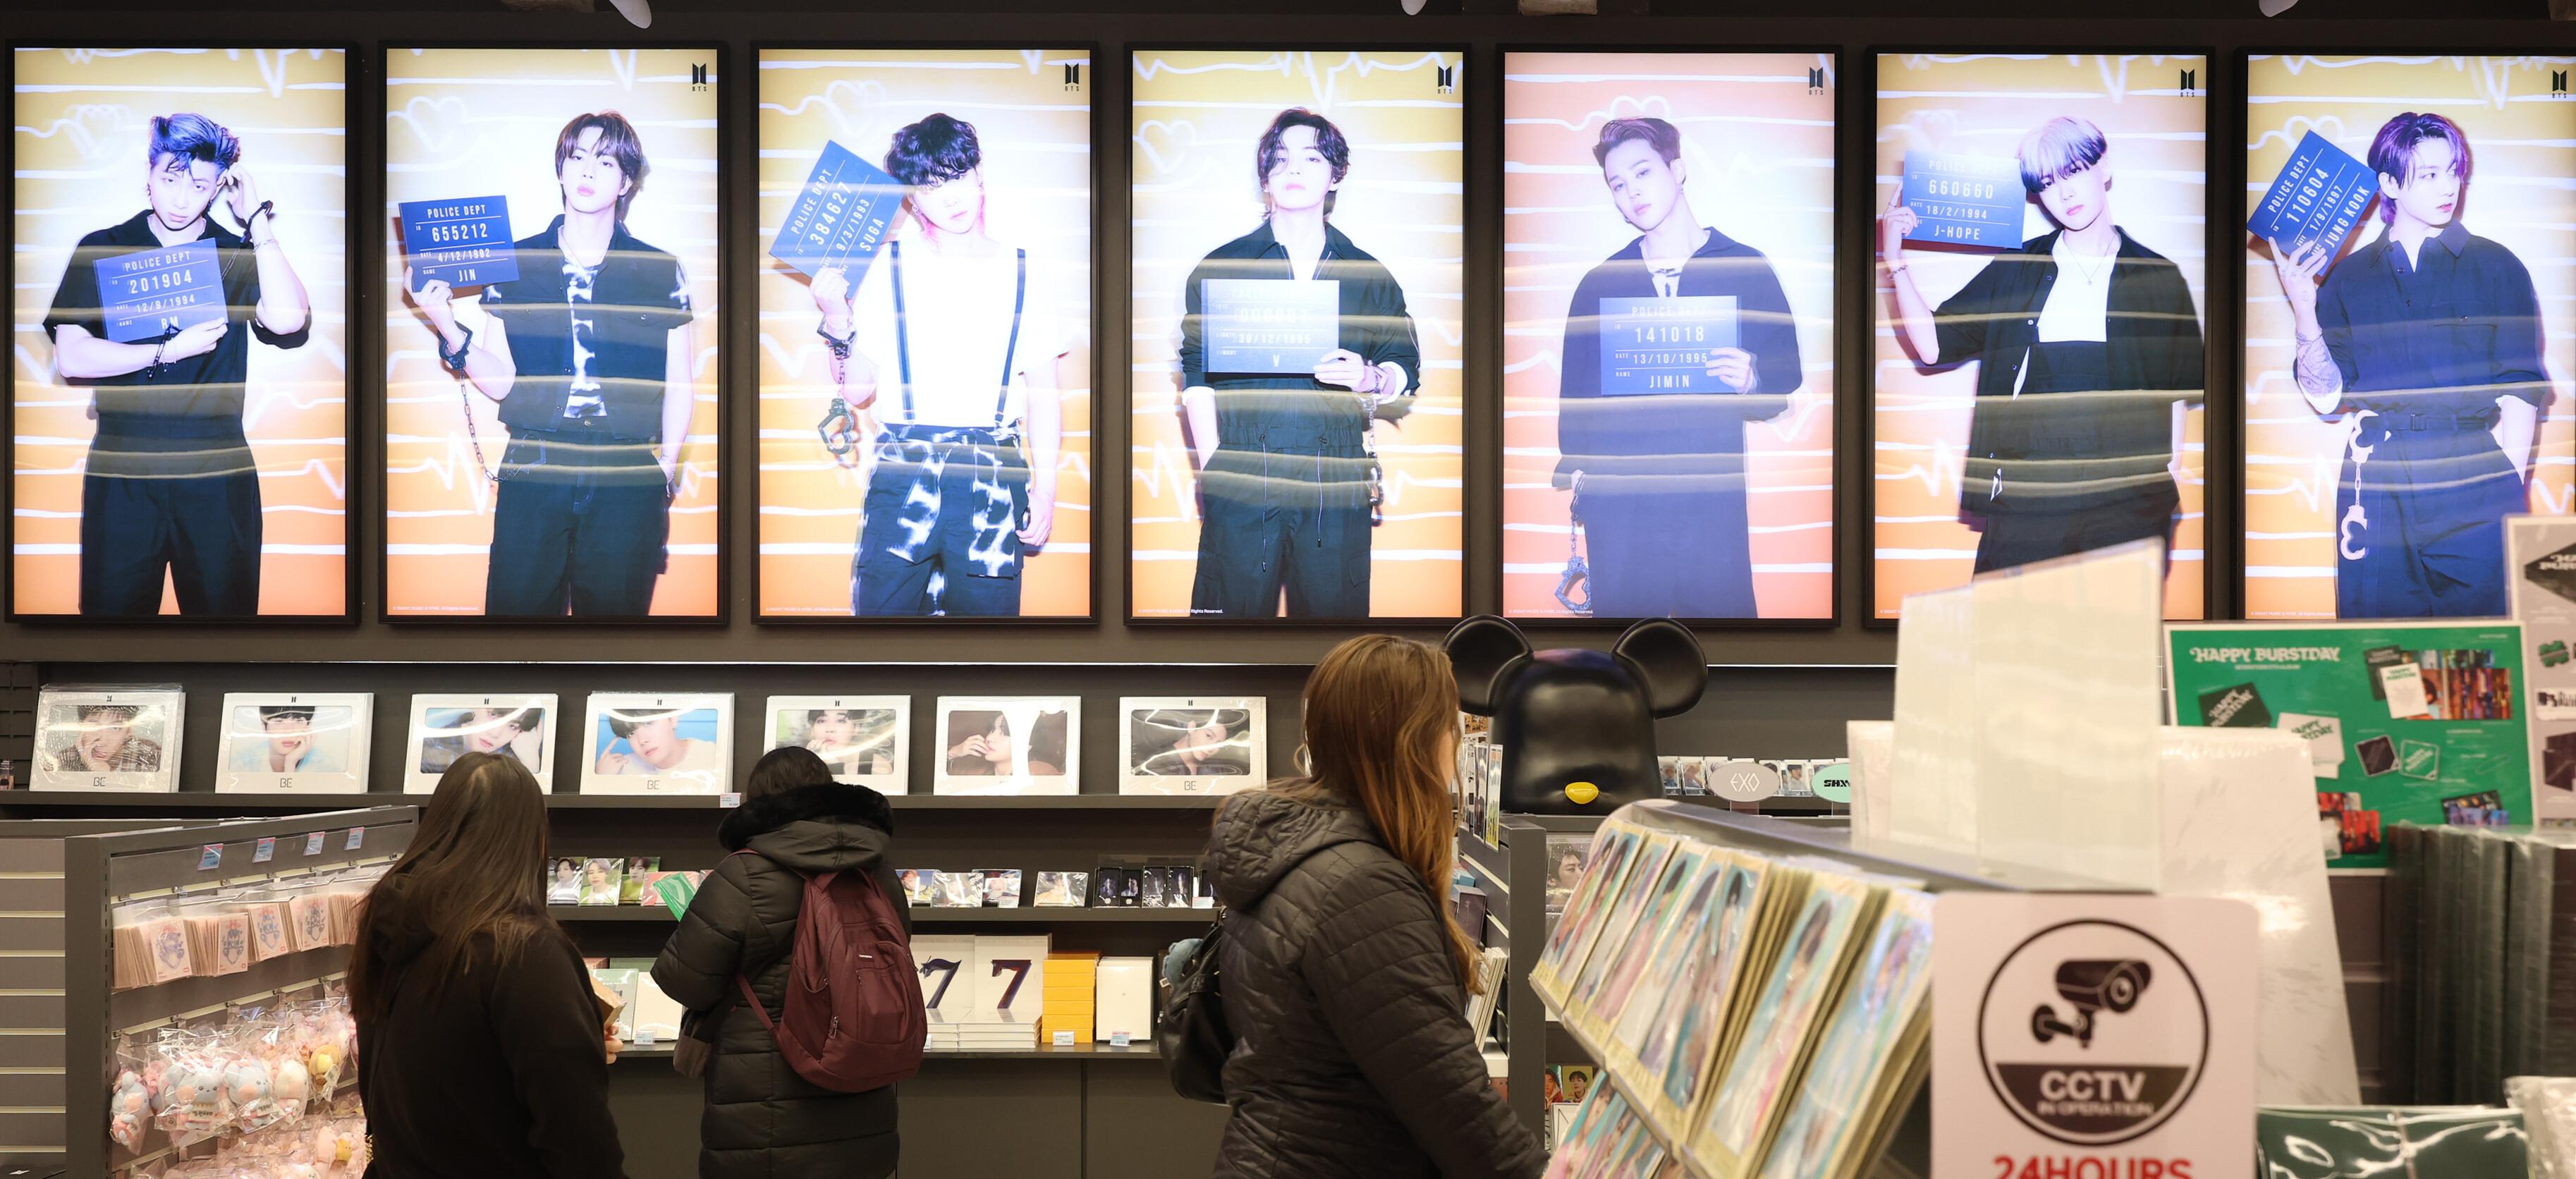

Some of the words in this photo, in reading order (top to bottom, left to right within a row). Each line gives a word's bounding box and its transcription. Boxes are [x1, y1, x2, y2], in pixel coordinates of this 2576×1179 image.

[1929, 179, 1994, 199] 660660
[2268, 179, 2294, 213] POLICE
[2290, 155, 2309, 179] DEPT
[790, 197, 817, 235] POLICE
[812, 169, 832, 196] DEPT
[2286, 168, 2329, 223] 110604
[427, 207, 459, 219] POLICE
[463, 204, 486, 215] DEPT
[810, 181, 853, 245] 384627
[1926, 205, 1986, 219] 18/2/1994
[2309, 185, 2343, 231] 1/9/1997
[2324, 217, 2349, 248] JUNG
[2343, 185, 2369, 217] KOOK
[432, 223, 488, 243] 655212
[836, 199, 870, 252] 9/3/1993
[1934, 225, 1980, 240] J-HOPE
[860, 218, 885, 252] SUGA
[2297, 235, 2307, 247] DATE
[124, 257, 161, 271] POLICE
[166, 251, 190, 264] DEPT
[438, 248, 490, 262] 4/12/1992
[130, 269, 193, 294] 201904
[458, 269, 476, 282] JIN
[135, 294, 195, 313] 12/9/1994
[1632, 306, 1671, 317] POLICE
[161, 316, 179, 330] RM
[1239, 334, 1312, 344] 30/12/1995
[1635, 326, 1704, 343] 141018
[1273, 355, 1280, 367] V
[1633, 353, 1707, 365] 13/10/1995
[1649, 374, 1690, 388] JIMIN
[2190, 647, 2251, 663] HAPPY
[2254, 647, 2340, 661] BURSTDAY
[93, 776, 106, 787] BE
[279, 778, 293, 788] BE
[647, 780, 660, 790] BE
[1184, 781, 1197, 790] BE
[1730, 772, 1760, 793] EXO
[991, 960, 1032, 1008] 7
[2039, 1070, 2146, 1101] CCTV
[2038, 1101, 2055, 1116] IN
[2058, 1101, 2154, 1116] OPERATION
[1994, 1155, 2193, 1179] 24HOURS
